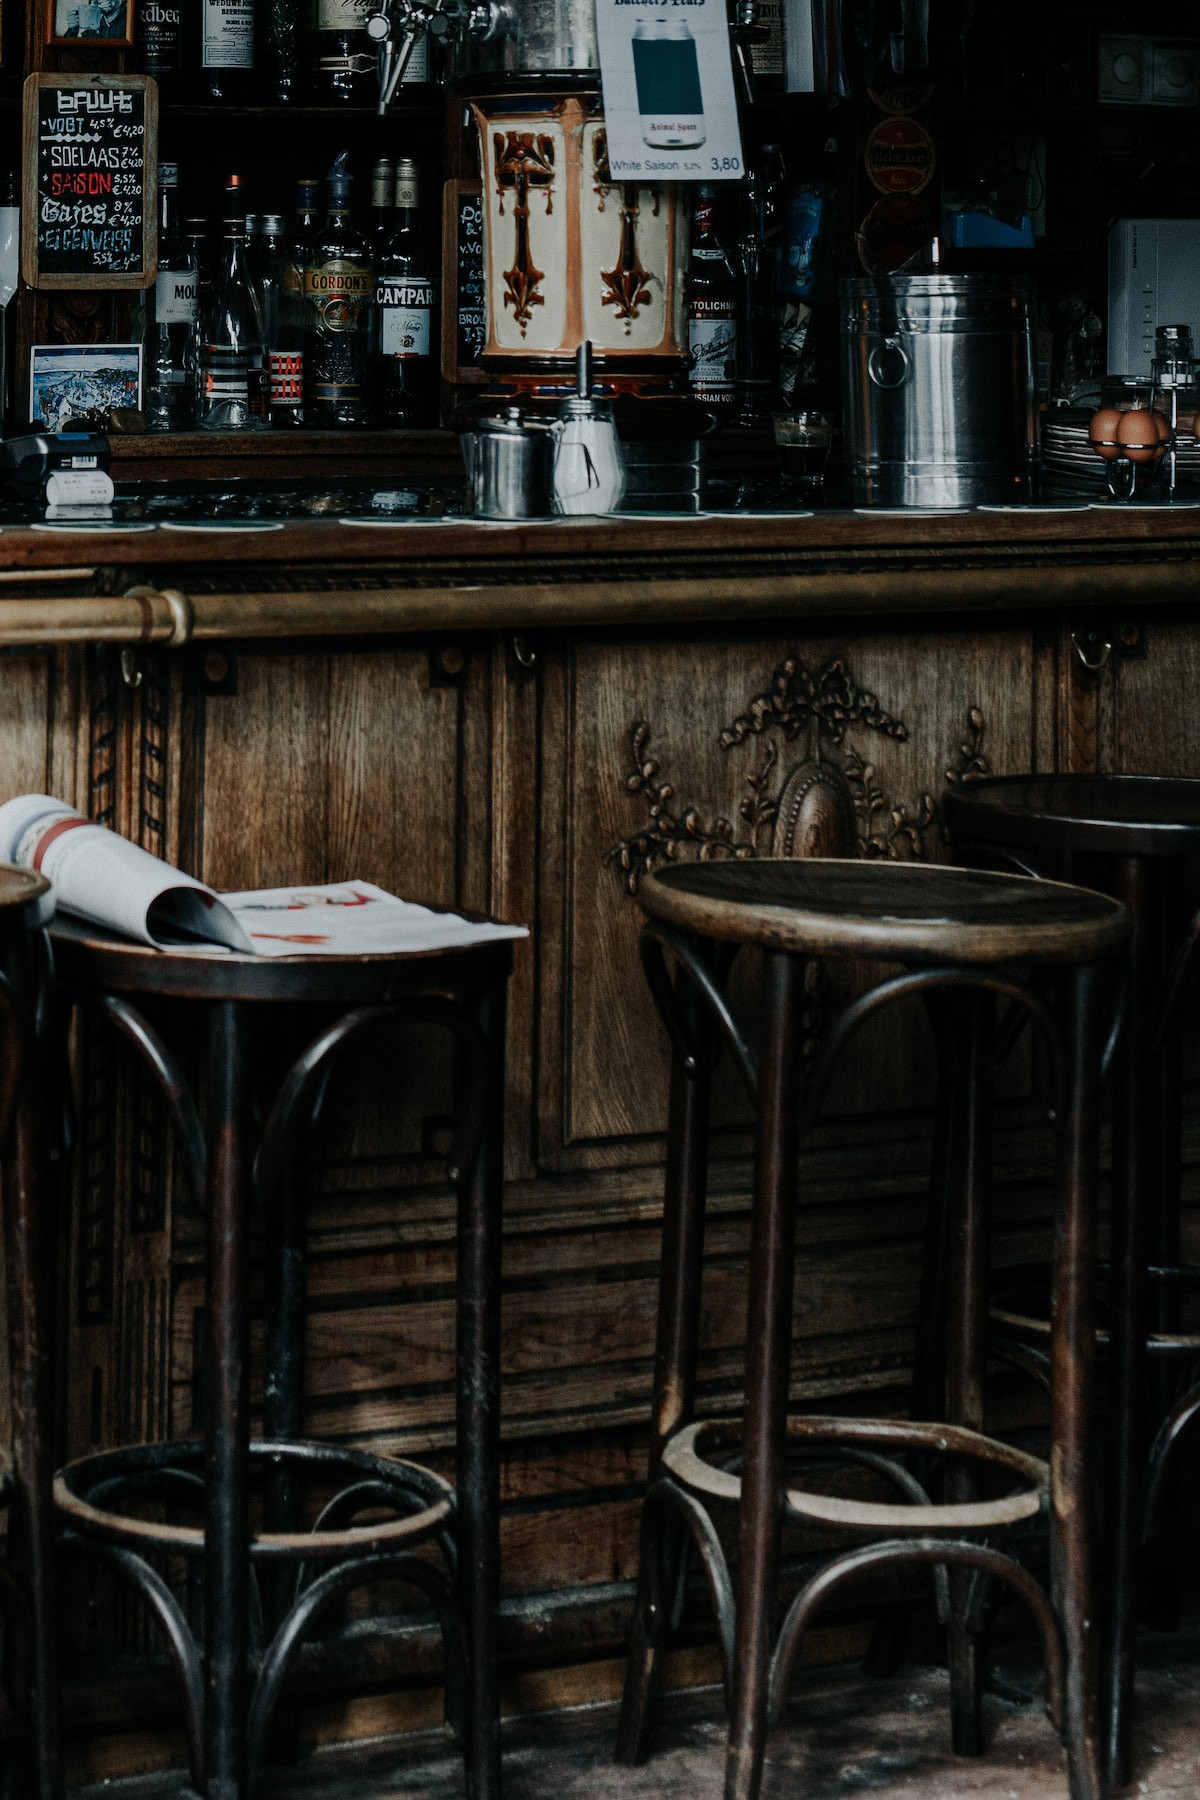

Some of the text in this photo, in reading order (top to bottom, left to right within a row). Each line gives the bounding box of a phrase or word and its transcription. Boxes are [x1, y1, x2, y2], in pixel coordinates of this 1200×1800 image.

[90, 118, 113, 129] 4,5%
[113, 125, 144, 138] €4,20
[122, 147, 138, 157] 7%
[612, 157, 740, 171] White Saison 3,80
[114, 174, 136, 183] 5,5%
[112, 185, 142, 195] €4,20
[114, 202, 133, 213] 8%
[108, 215, 142, 227] €4,20
[312, 274, 368, 290] GORDON'S
